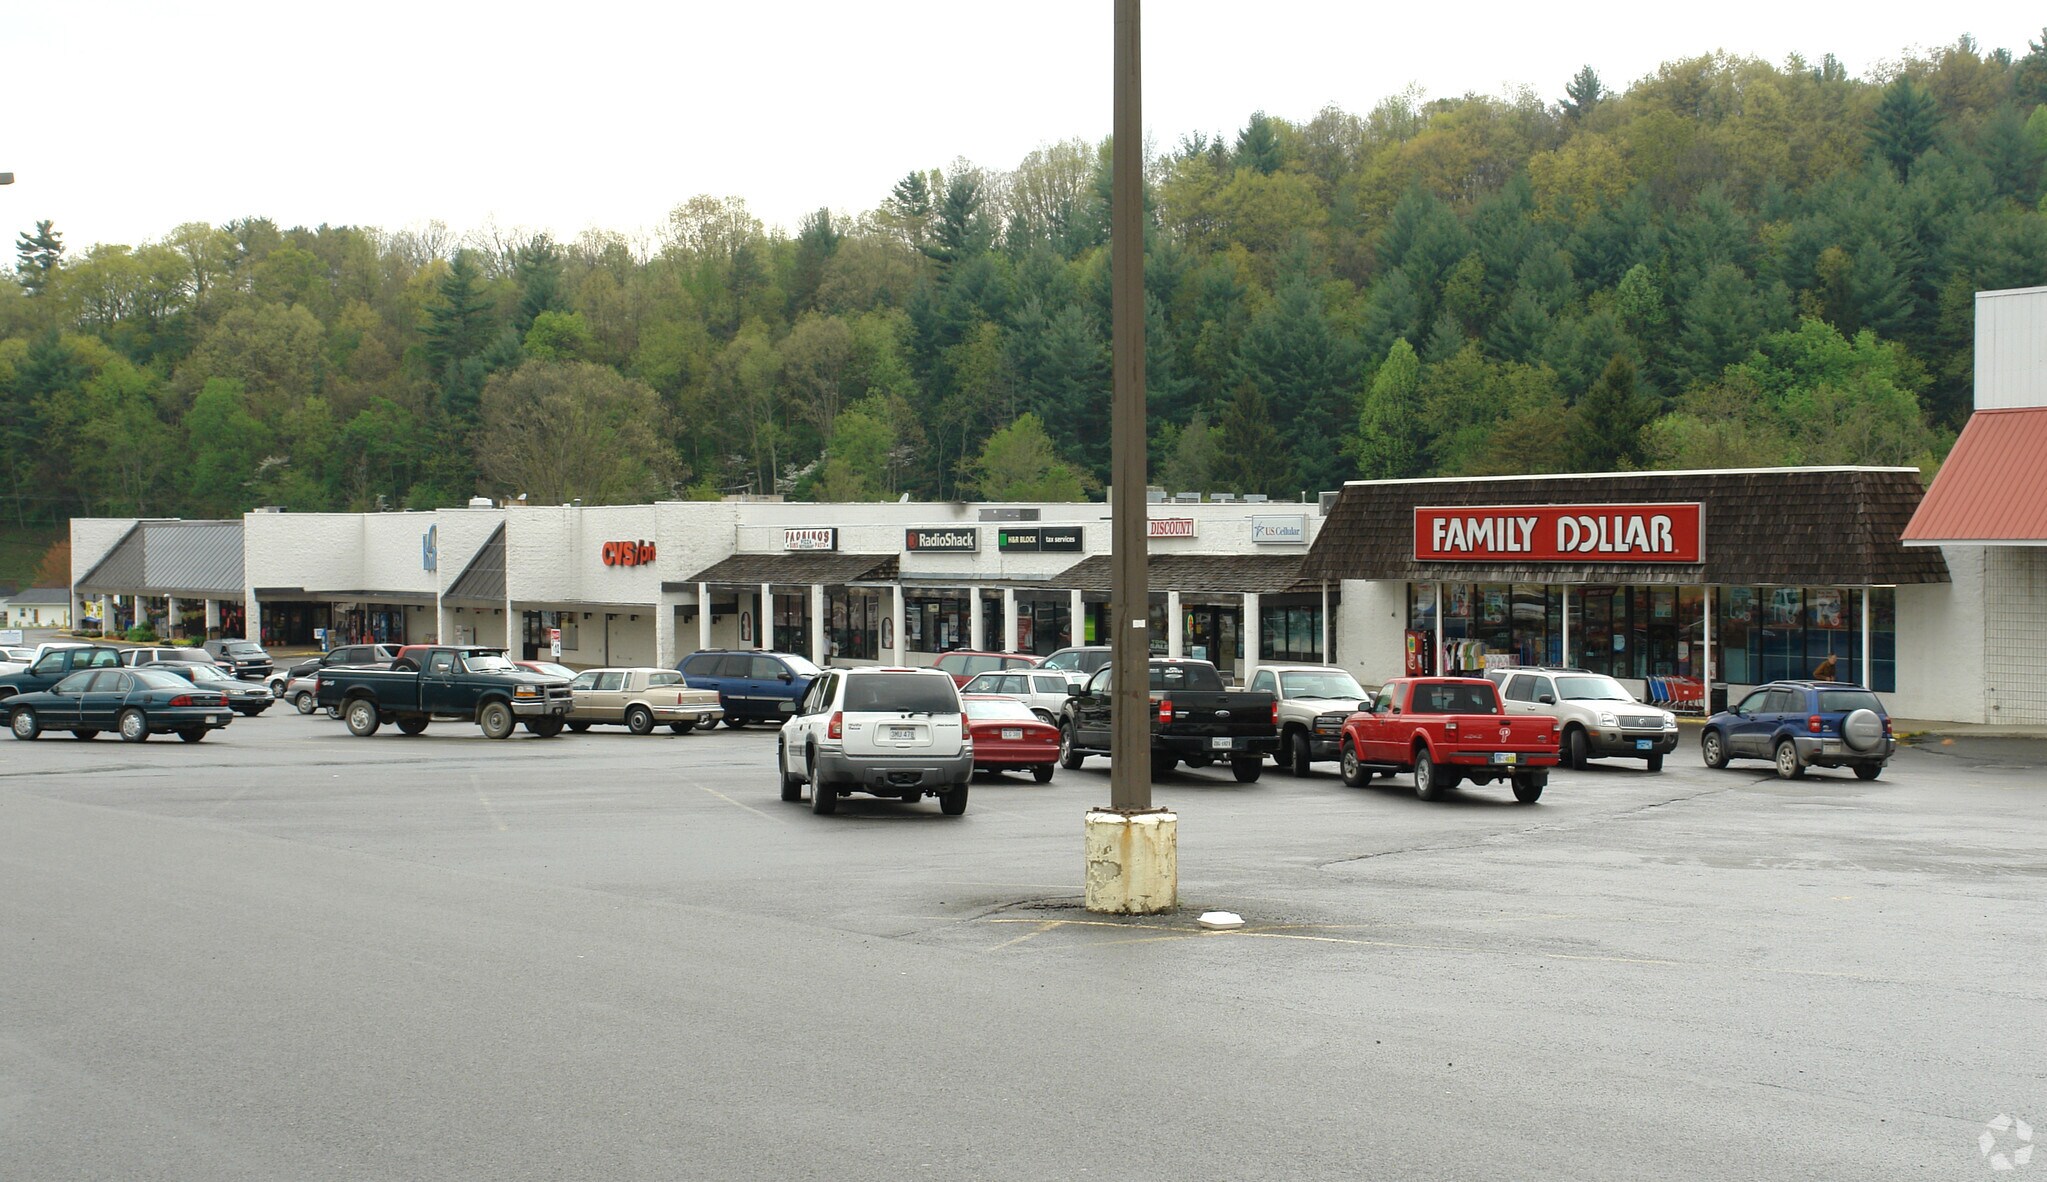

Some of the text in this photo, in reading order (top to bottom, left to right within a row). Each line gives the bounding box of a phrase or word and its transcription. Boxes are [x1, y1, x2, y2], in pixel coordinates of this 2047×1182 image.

[1150, 521, 1192, 535] DISCOUNT
[1275, 526, 1301, 536] Cellular
[1433, 515, 1673, 553] FAMILY DOLLAR
[919, 532, 974, 547] RadioShack
[1008, 536, 1037, 544] H&R BLOCK
